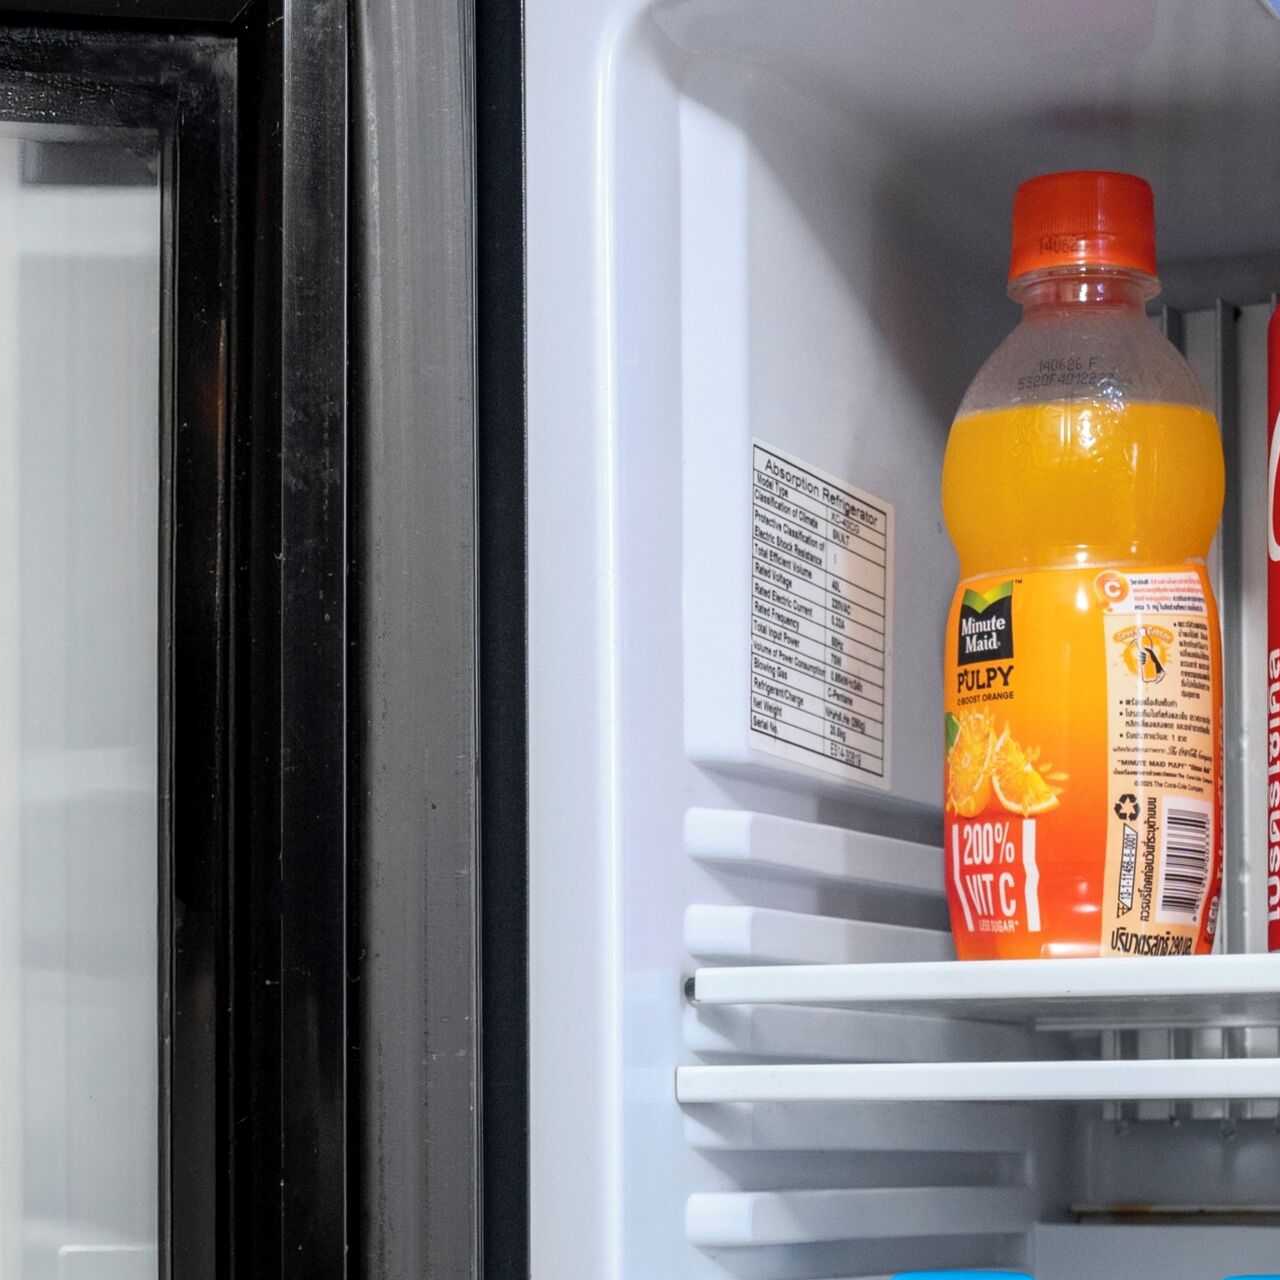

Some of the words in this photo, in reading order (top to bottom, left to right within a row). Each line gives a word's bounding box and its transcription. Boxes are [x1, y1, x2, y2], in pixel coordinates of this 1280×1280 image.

[756, 471, 775, 492] Model
[774, 480, 788, 501] Type
[764, 455, 819, 499] Absorption
[821, 486, 878, 532] Refrigerator
[754, 487, 791, 517] Classification
[798, 509, 818, 530] Climate
[754, 508, 782, 533] Protective
[783, 522, 818, 550] Classification
[754, 524, 775, 545] Electric
[776, 534, 793, 553] Shock
[794, 543, 822, 567] Resistance
[754, 542, 768, 559] Total
[769, 549, 791, 570] Efficient
[792, 560, 812, 580] Volume
[754, 561, 771, 580] Rated
[771, 569, 792, 591] Voltage
[754, 581, 771, 600] Rated
[771, 589, 792, 608] Electric
[791, 598, 813, 618] Current
[754, 600, 770, 618] Rated
[771, 608, 800, 633] Frequency
[961, 615, 1006, 637] Minute
[753, 619, 767, 636] Total
[768, 625, 782, 644] Input
[782, 631, 800, 649] Power
[965, 632, 998, 654] Maid
[753, 657, 776, 679] Blowing
[776, 666, 787, 681] Gas
[778, 649, 793, 665] Power
[793, 656, 825, 680] Consumption
[957, 665, 1014, 694] PULPY
[753, 676, 803, 709] Refrigerant/Charge
[982, 691, 1014, 702] ORANGE
[752, 714, 769, 731] Serial
[763, 699, 782, 720] Weight
[1149, 760, 1166, 768] MAID
[1163, 781, 1188, 790] Coca-Cola
[1187, 784, 1204, 793] Company
[963, 821, 1016, 865] 200%
[965, 873, 994, 916] VIT
[998, 871, 1017, 917] C
